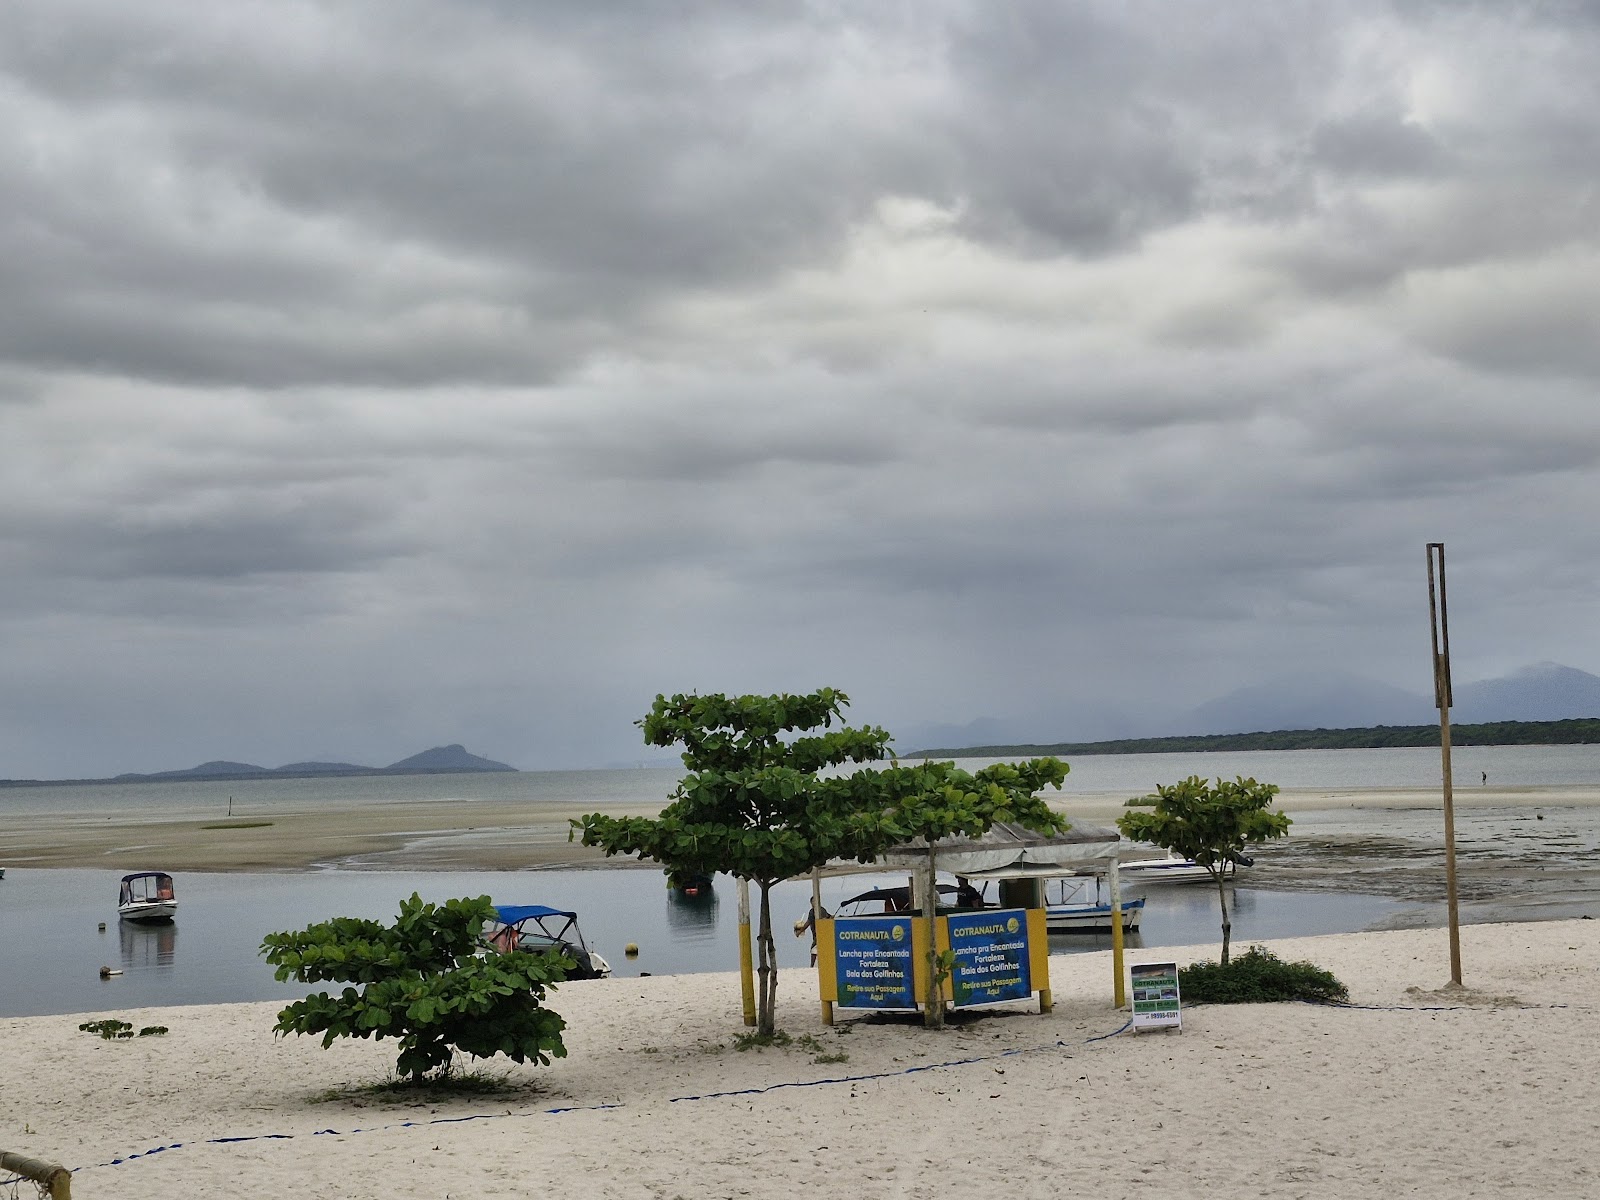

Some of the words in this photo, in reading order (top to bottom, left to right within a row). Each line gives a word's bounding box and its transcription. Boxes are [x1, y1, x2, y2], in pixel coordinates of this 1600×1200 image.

[954, 925, 1005, 936] COTRANAUTA
[839, 931, 890, 940] COTRANAUTA
[978, 946, 989, 954] pra
[990, 941, 1024, 951] Encantada
[839, 949, 862, 957] Lancha
[863, 951, 874, 959] pra
[874, 949, 910, 957] Encantada
[974, 954, 1005, 963] Fortaleza
[859, 960, 889, 968] Fortaleza
[977, 964, 989, 973] dos
[990, 962, 1020, 972] Golfinhos
[861, 970, 873, 978] dos
[873, 970, 904, 978] Golfinhos
[992, 977, 1022, 987] Passagem
[875, 985, 906, 994] Passagem
[987, 988, 1000, 997] Aqui
[870, 993, 884, 1002] Aqui
